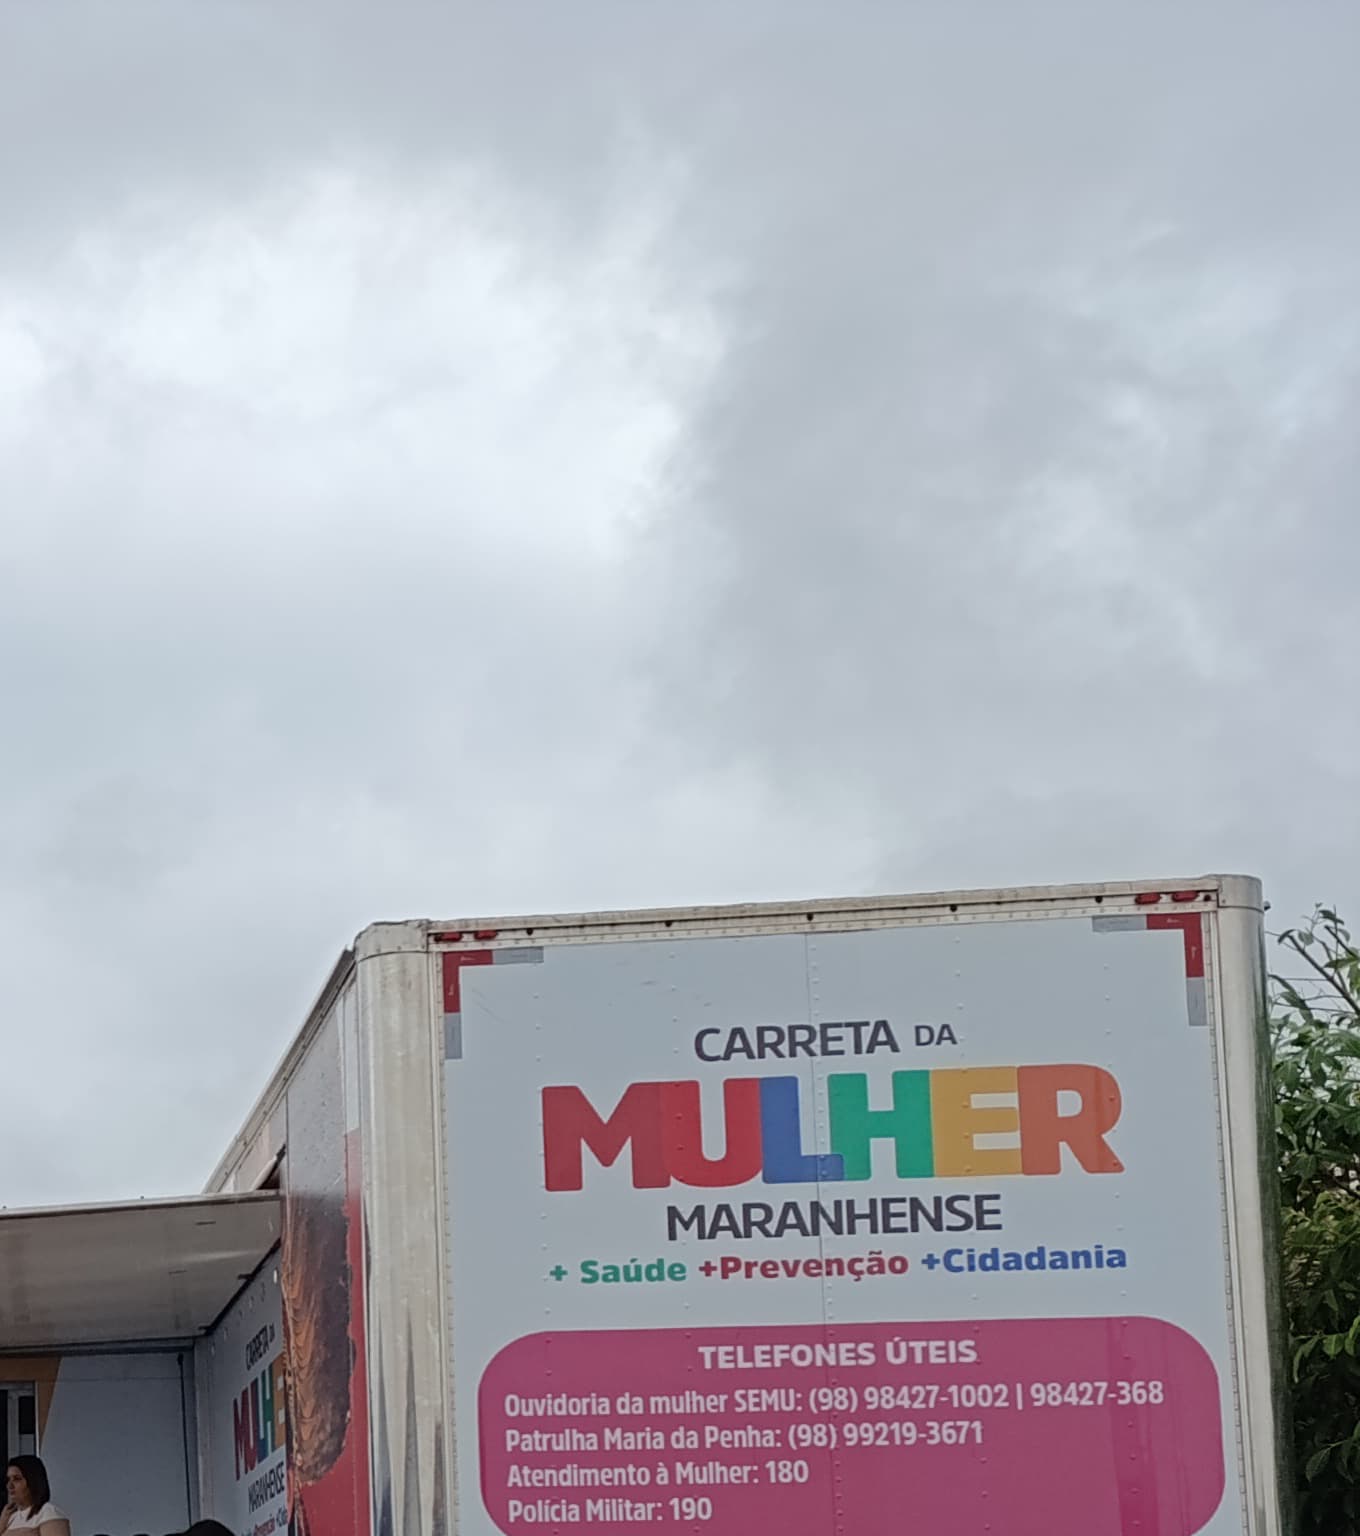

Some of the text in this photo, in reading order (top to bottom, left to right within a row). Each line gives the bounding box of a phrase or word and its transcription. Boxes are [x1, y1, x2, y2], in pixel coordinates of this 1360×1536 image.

[694, 1020, 958, 1062] CARRETA DA
[542, 1064, 1125, 1192] MULHER
[667, 1194, 1002, 1241] MARANHENSE
[580, 1258, 687, 1284] Saúde
[699, 1250, 909, 1282] +Prevenção
[921, 1245, 1127, 1273] +Cidadania
[698, 1337, 978, 1369] TELEFONES ÚTEIS
[233, 1351, 286, 1482] MULHE
[505, 1394, 610, 1417] Ouvidoria
[616, 1393, 644, 1415] da
[650, 1391, 728, 1414] mulher
[734, 1389, 803, 1412] SEMU:
[809, 1387, 858, 1413] (98)
[864, 1385, 1009, 1411] 98427-1002
[1031, 1381, 1164, 1406] 98427-368
[505, 1421, 983, 1452] Patrulha Maria da Penha: (98) 99219-3671
[507, 1460, 809, 1488] Atendimento à Mulher: 180
[508, 1497, 712, 1523] Polícia Militar: 190
